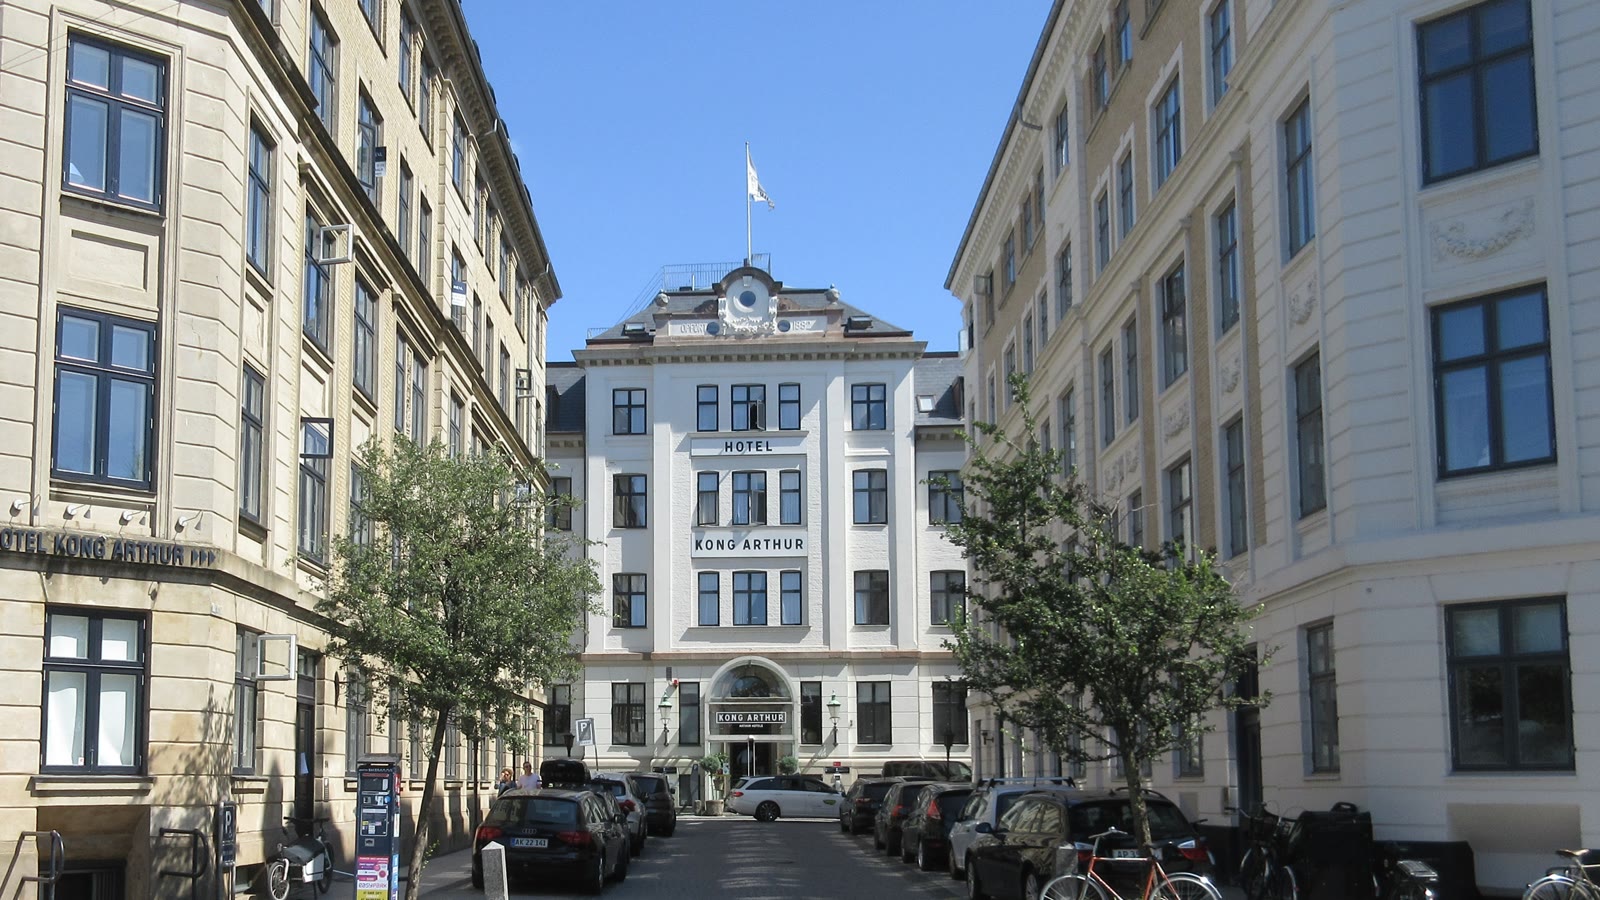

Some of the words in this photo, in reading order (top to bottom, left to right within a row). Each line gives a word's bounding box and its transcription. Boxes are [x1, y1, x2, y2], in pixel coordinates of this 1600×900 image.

[725, 441, 773, 452] HOTEL
[0, 528, 48, 554] OTEL
[54, 533, 106, 559] KONG
[111, 539, 185, 566] ARTHUR
[695, 539, 736, 551] KONG
[743, 538, 804, 550] ARTHUR
[718, 714, 744, 722] KONG
[747, 713, 784, 722] ARTHUR
[580, 722, 588, 733] P
[225, 810, 232, 834] P
